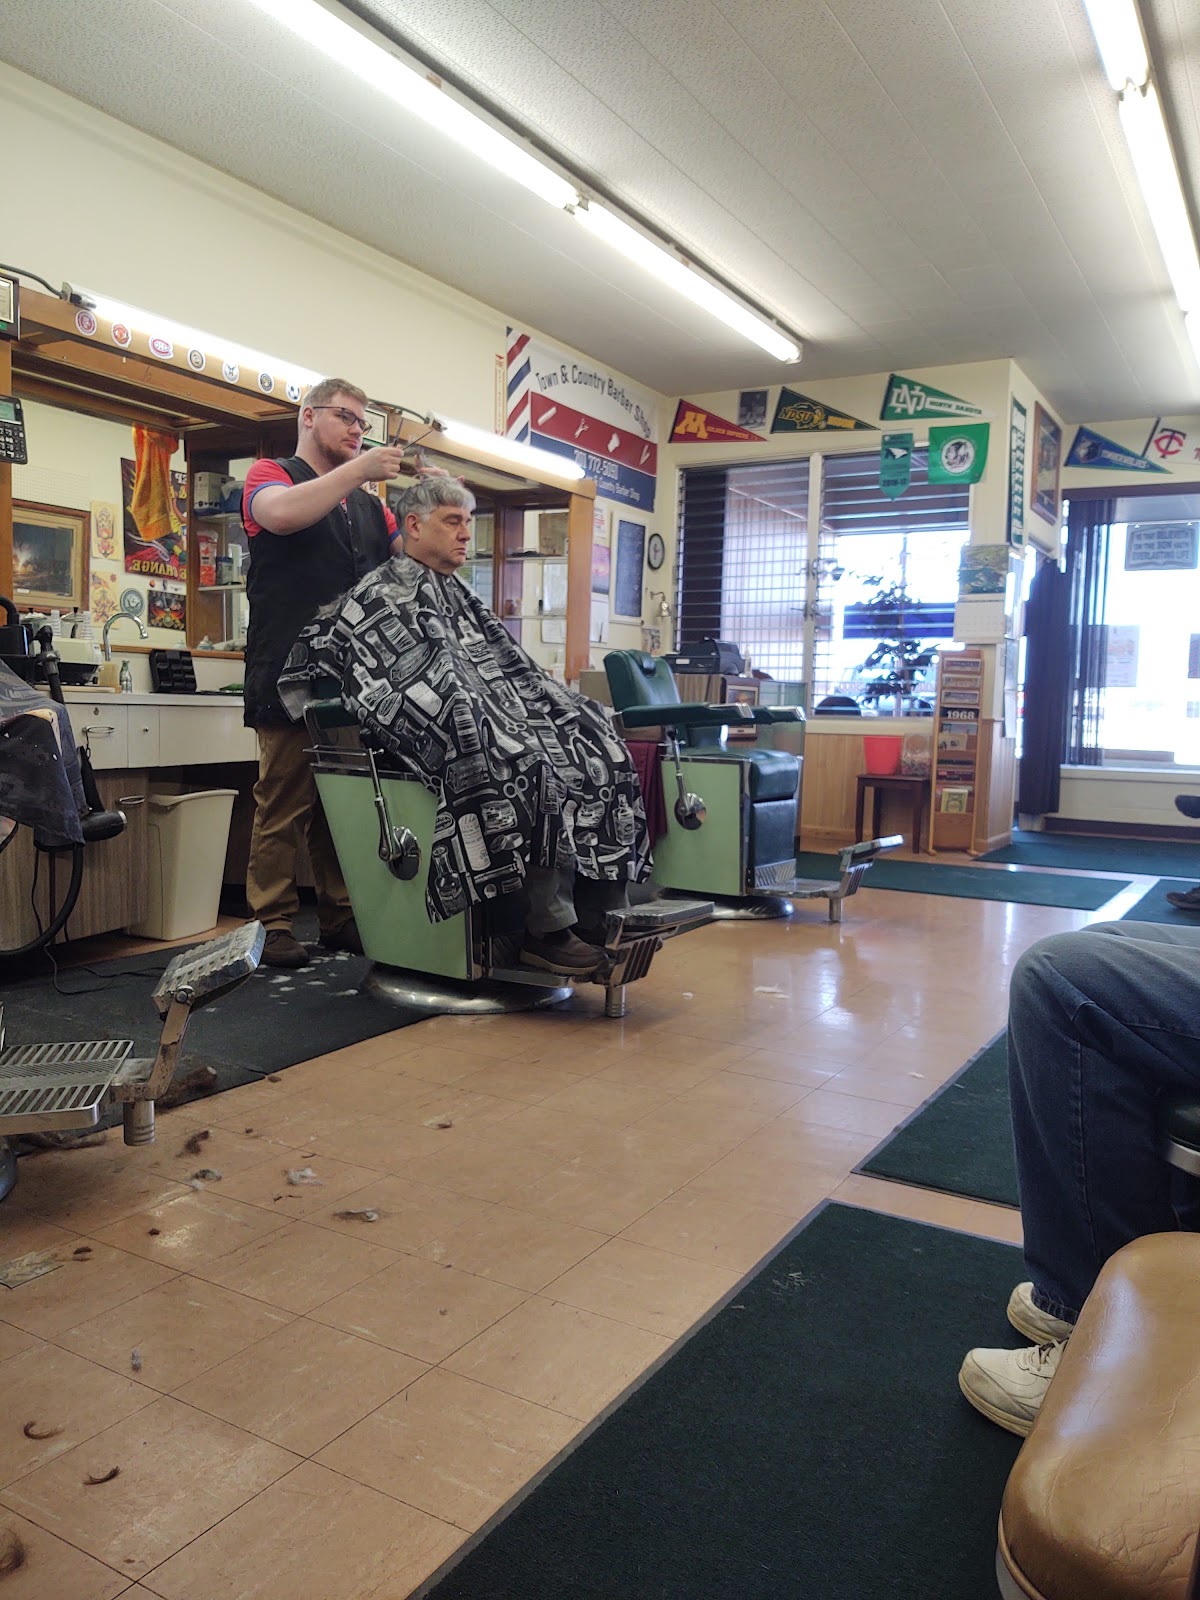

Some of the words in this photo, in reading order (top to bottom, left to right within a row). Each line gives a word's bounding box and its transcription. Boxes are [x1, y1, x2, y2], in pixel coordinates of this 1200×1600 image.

[535, 372, 559, 392] Town
[560, 364, 570, 384] &
[571, 364, 606, 396] Country
[606, 378, 633, 414] Barber
[634, 404, 652, 439] Shop
[674, 410, 709, 440] M
[779, 406, 817, 422] NDSU
[947, 710, 975, 720] 1968
